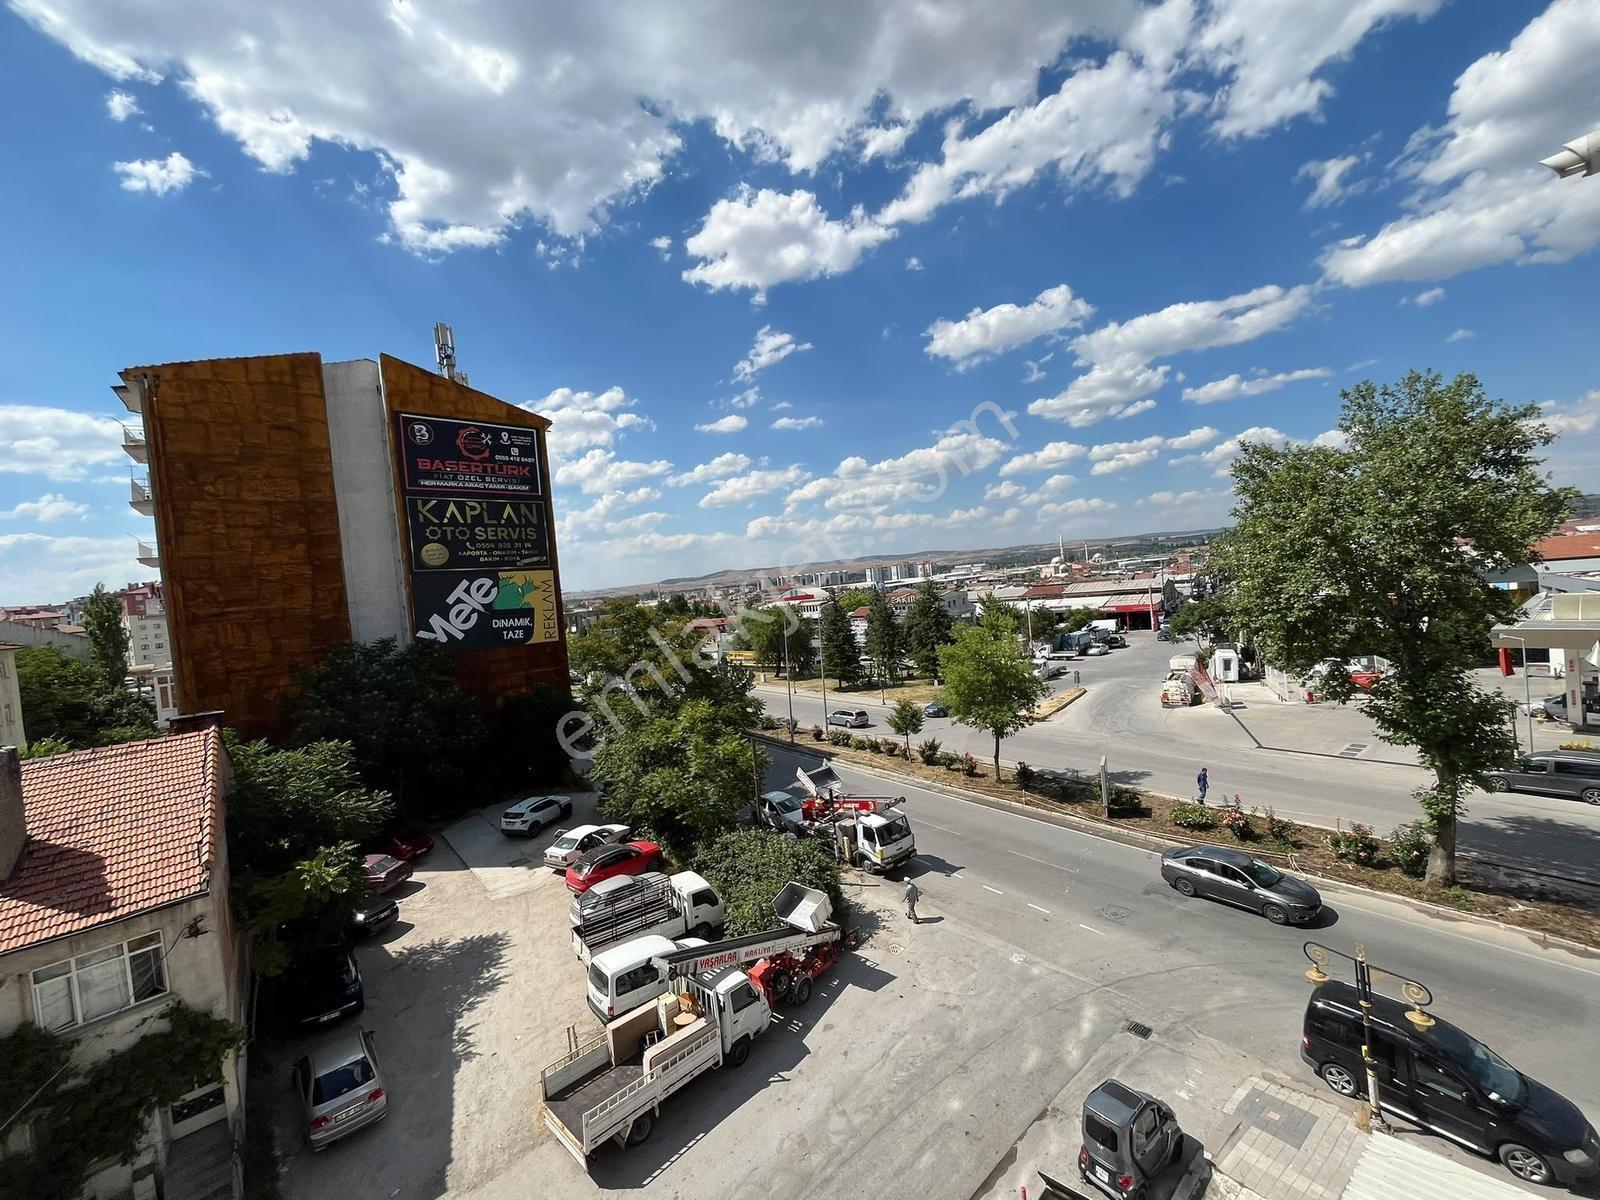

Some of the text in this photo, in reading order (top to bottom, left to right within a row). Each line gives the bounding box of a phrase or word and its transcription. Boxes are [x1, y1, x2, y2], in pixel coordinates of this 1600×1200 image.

[417, 499, 538, 525] KAPLAN
[425, 526, 470, 540] OTO
[543, 579, 558, 639] REKLAM
[503, 629, 525, 641] TAZE
[699, 951, 737, 970] YAŞARLAR
